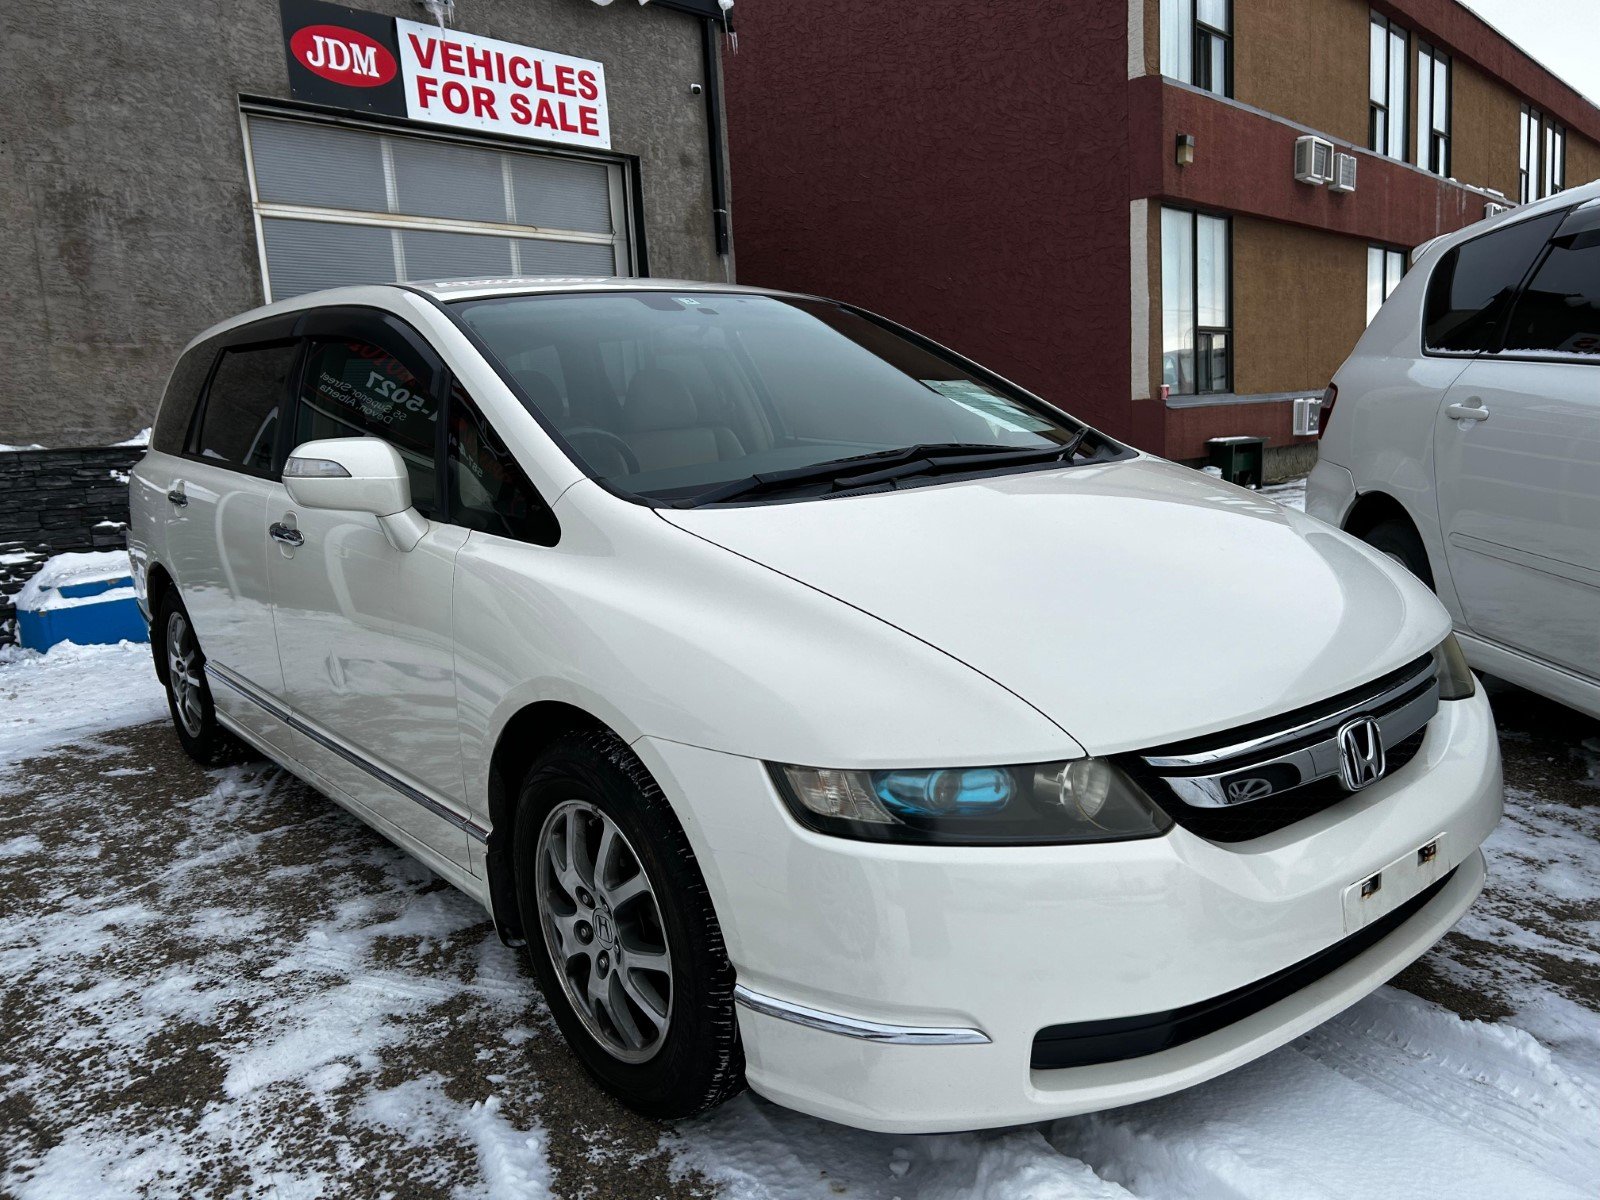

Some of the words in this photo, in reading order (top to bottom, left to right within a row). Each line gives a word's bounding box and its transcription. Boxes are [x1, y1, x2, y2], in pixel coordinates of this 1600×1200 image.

[306, 35, 380, 78] JDM
[407, 33, 599, 101] VEHICLES
[416, 75, 499, 120] FOR
[510, 93, 600, 137] SALE
